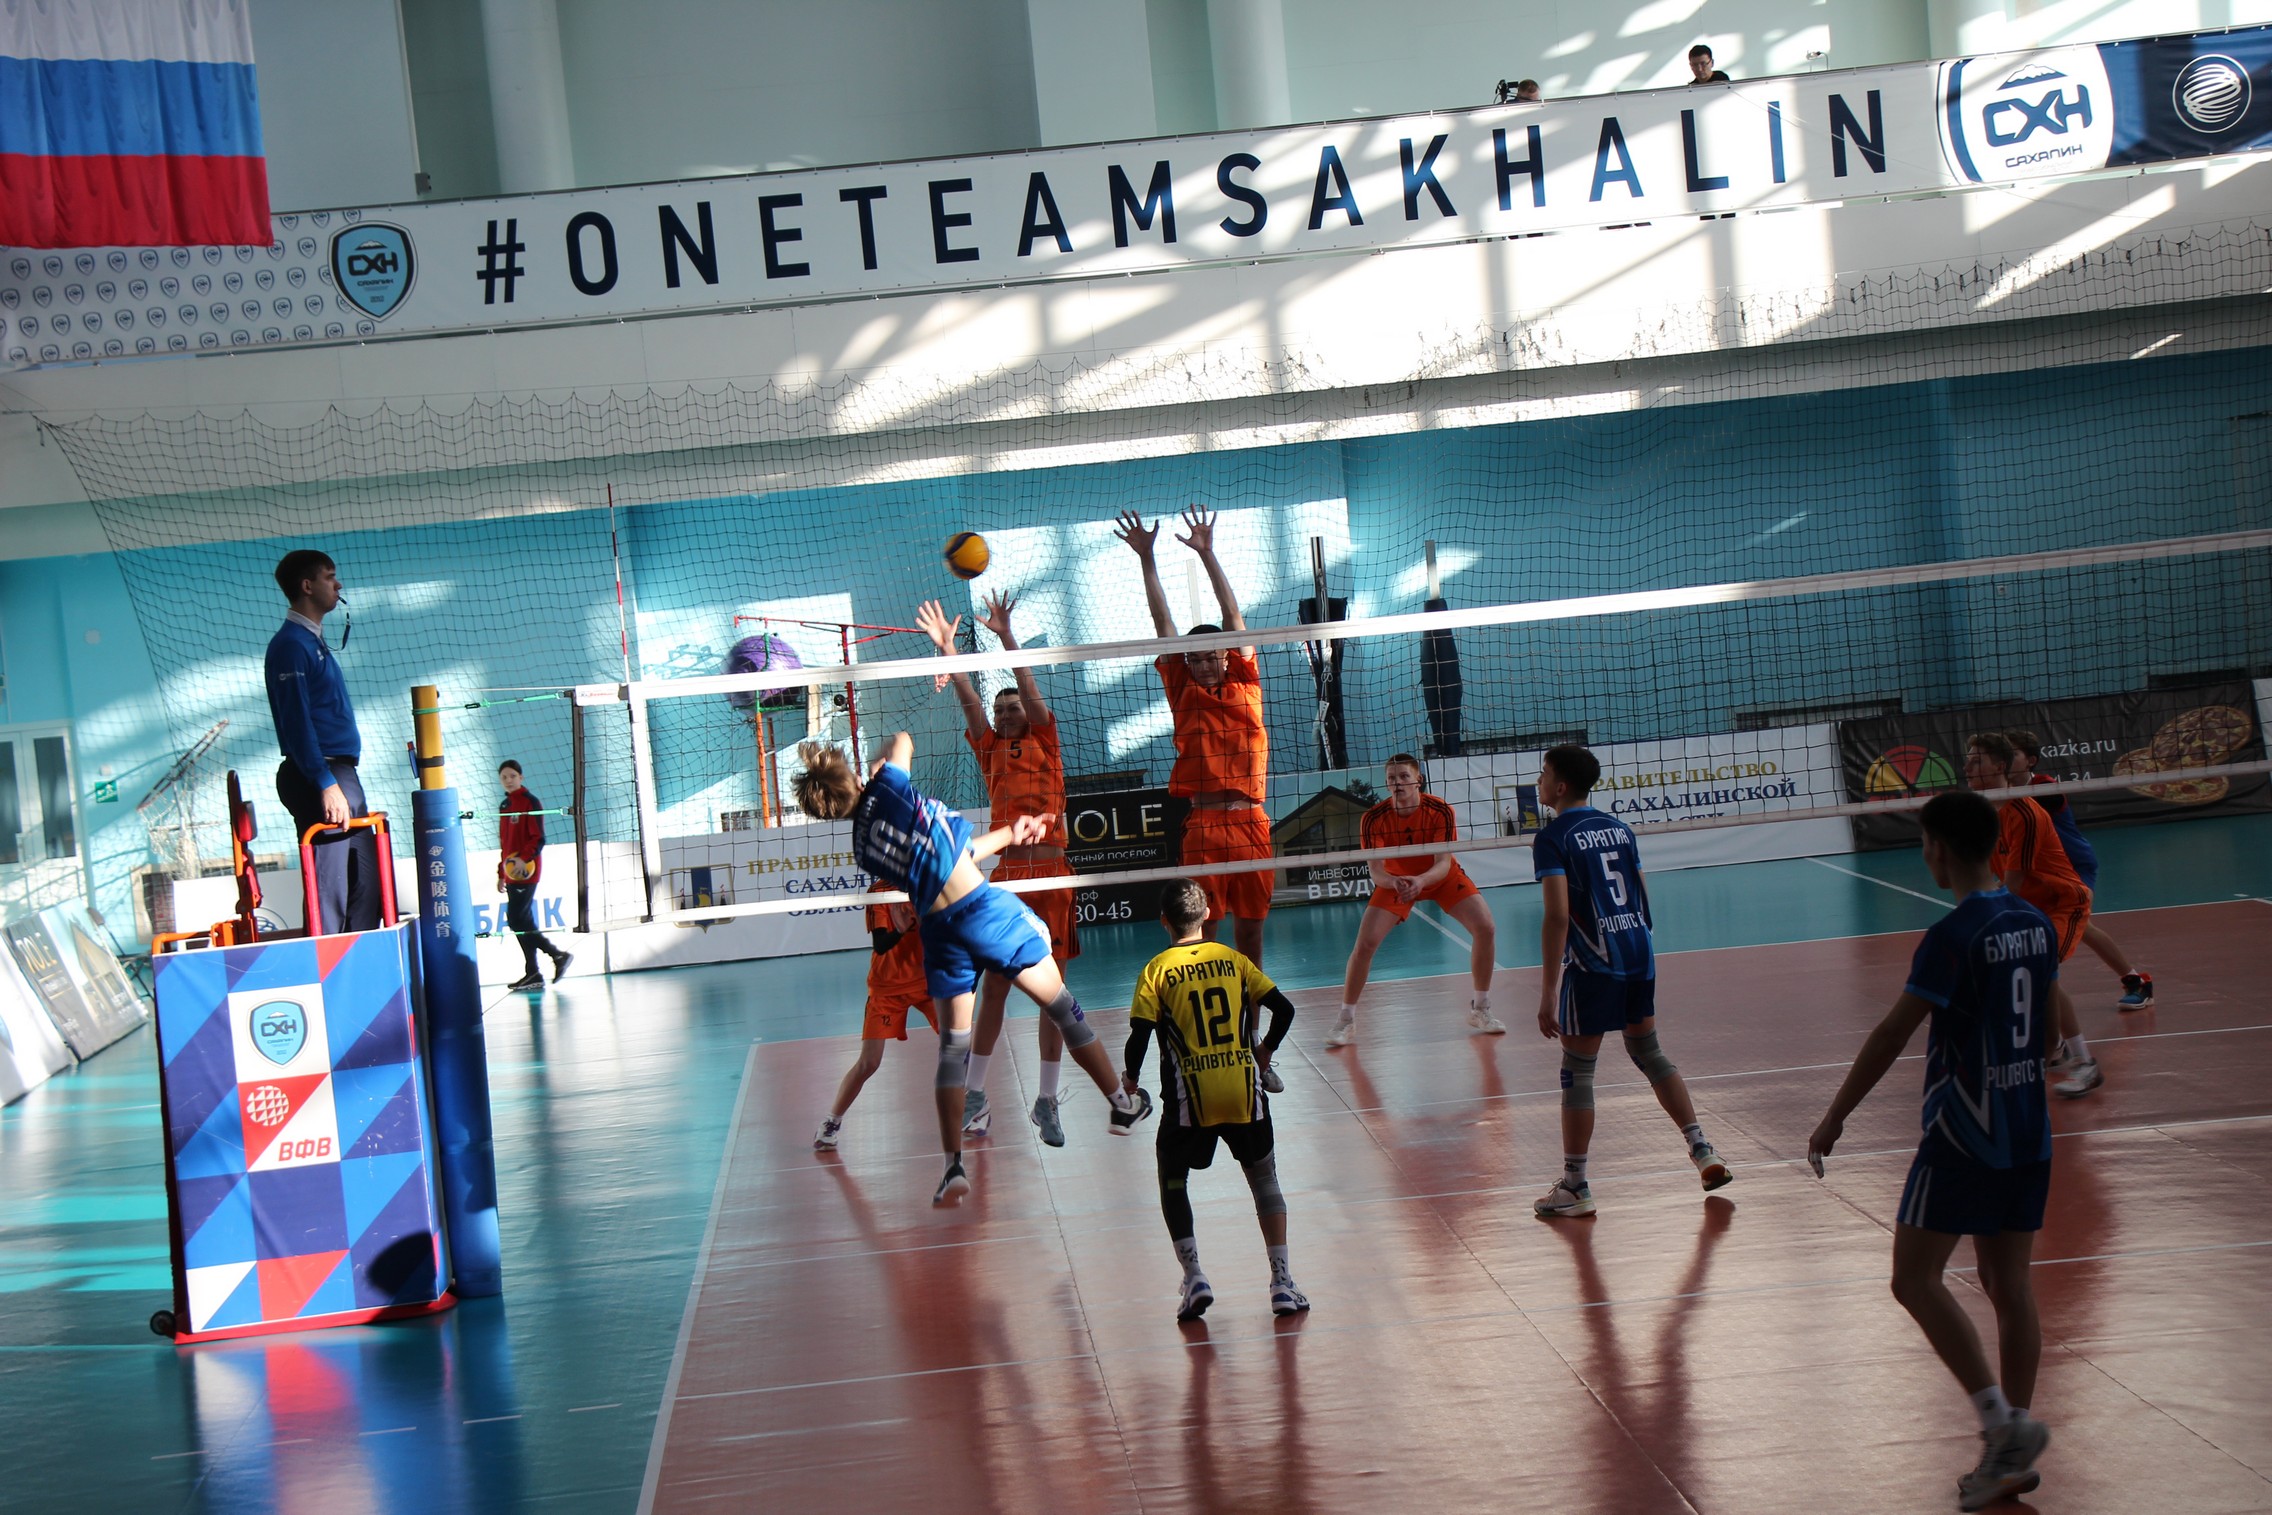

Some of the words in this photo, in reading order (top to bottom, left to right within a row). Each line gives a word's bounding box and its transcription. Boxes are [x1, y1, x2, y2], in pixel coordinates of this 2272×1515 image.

[476, 89, 1886, 305] #ONETEAMSAKHALIN
[1010, 740, 1022, 760] 5
[1592, 761, 1777, 792] РАВИТЕЛЬСТВО
[1611, 777, 1798, 815] САХАЛИНСКОЙ
[1065, 804, 1165, 844] OLE
[1573, 827, 1631, 851] БУРЯТИЯ
[747, 852, 854, 876] ПРАВИТЕ
[1308, 865, 1370, 881] ИНВЕСТИР
[1600, 851, 1628, 907] 5
[430, 861, 450, 938] 金陵体育
[1075, 890, 1099, 903] .рф
[1308, 884, 1322, 899] В
[1984, 927, 2047, 963] БУРЯТИЯ
[1165, 959, 1236, 988] БУРЯТИЯ
[1188, 986, 1235, 1048] 12
[2012, 967, 2032, 1049] 9
[1183, 1050, 1235, 1073] РЦПВТС
[278, 1136, 332, 1162] ВФВ
